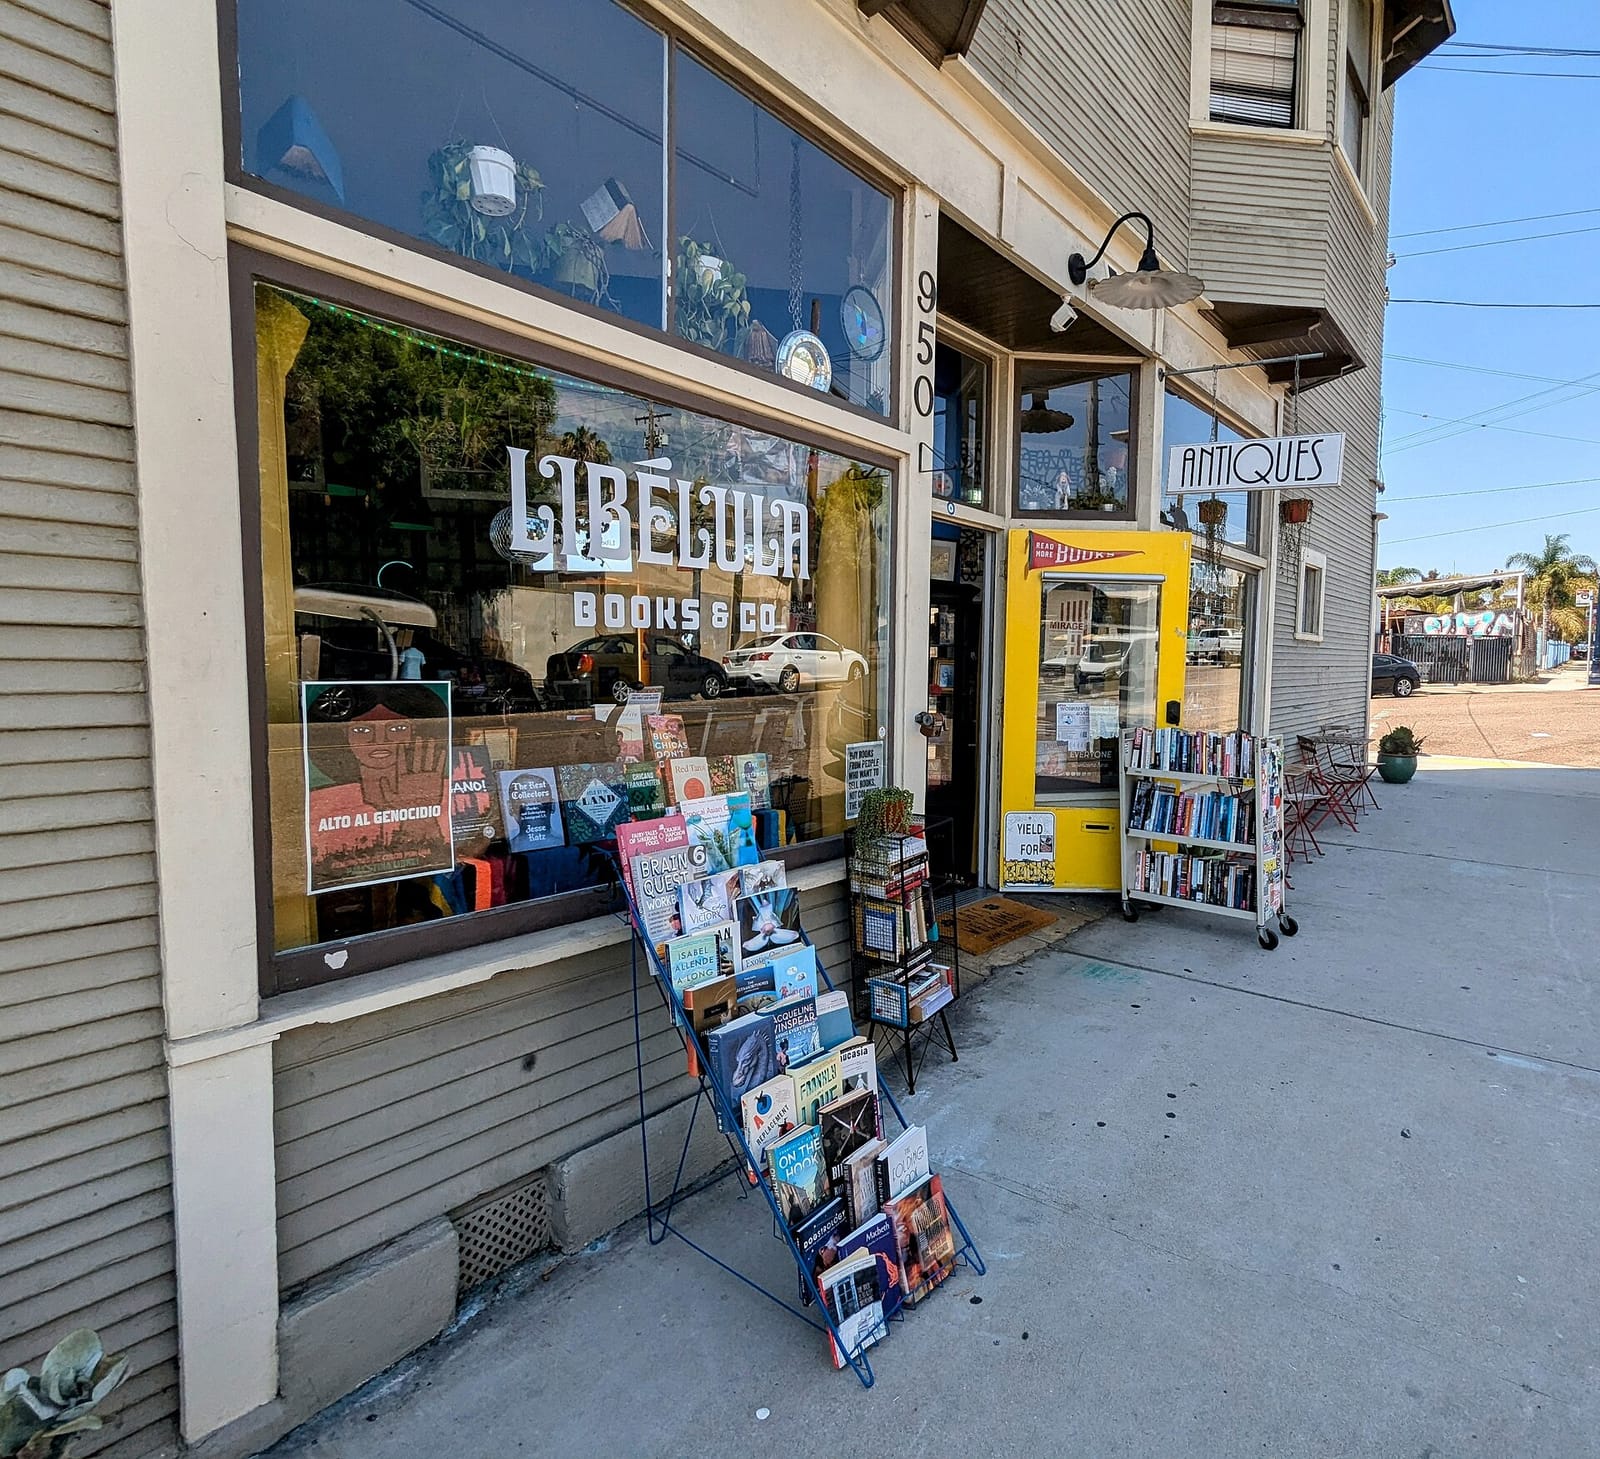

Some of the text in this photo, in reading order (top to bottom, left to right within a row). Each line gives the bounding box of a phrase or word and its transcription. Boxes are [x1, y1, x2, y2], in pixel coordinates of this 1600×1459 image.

[914, 270, 936, 417] 950
[1180, 439, 1323, 487] ANTIQUES
[506, 446, 810, 580] LIBÉLULA
[1036, 542, 1054, 550] READ
[1055, 543, 1115, 563] BOOKS
[573, 591, 699, 630] BOOKS
[711, 601, 729, 629] &
[1050, 622, 1083, 631] MIRAGE
[652, 732, 668, 740] BIG
[655, 742, 688, 750] CHICAS
[656, 751, 684, 759] DON'T
[859, 749, 874, 759] BOOKS
[1070, 751, 1112, 759] EVERYONE
[675, 765, 689, 773] Red
[849, 759, 879, 770] FROM PEOPLE
[849, 768, 879, 780] WHO WANT TO
[450, 780, 487, 793] ANO!
[512, 782, 527, 791] The
[849, 781, 858, 790] SELL
[511, 790, 549, 800] Collectors
[582, 794, 616, 805] LAND
[849, 801, 857, 811] THE
[318, 805, 441, 832] ALTO AL GENOCIDIO
[1017, 823, 1043, 835] YIELD
[692, 845, 706, 866] 6
[1021, 844, 1039, 856] FOR
[640, 852, 687, 879] BRAIN
[643, 871, 688, 898] QUEST
[647, 895, 677, 910] WORKB
[678, 946, 708, 961] ISABEL
[675, 956, 714, 972] ALLENDE
[677, 969, 714, 985] A LONG
[773, 1003, 815, 1023] ACQUELINE
[774, 1013, 815, 1034] INSPEAR
[800, 1063, 837, 1101] FRANKLY
[753, 1115, 765, 1130] A
[756, 1104, 790, 1147] REPLACEMENT
[779, 1137, 821, 1169] ON THE
[785, 1152, 819, 1181] HOOK
[769, 1168, 777, 1181] ON
[772, 1181, 780, 1198] THE
[803, 1210, 846, 1249] DOGSTROLOGY
[865, 1221, 890, 1242] Macbeth
